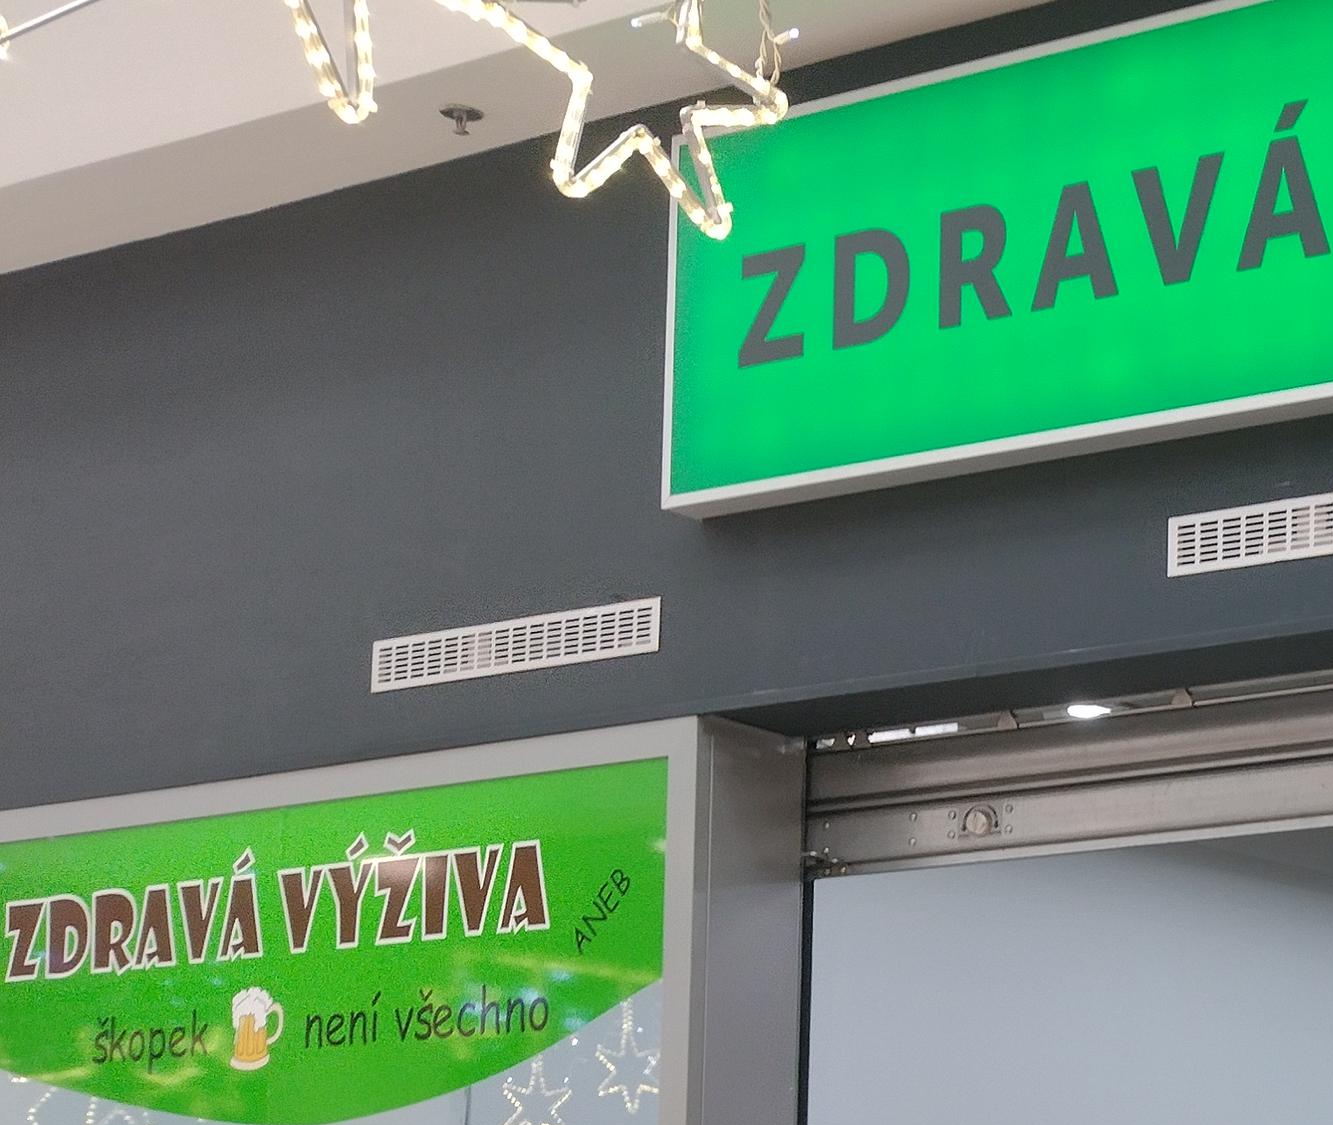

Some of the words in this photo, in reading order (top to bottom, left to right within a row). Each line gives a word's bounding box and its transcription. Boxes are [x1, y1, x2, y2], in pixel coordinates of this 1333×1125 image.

[738, 98, 1331, 369] ZDRAVÁ
[3, 847, 262, 982] ZDRAVÁ
[277, 828, 549, 954] VÝŽIVA
[572, 867, 632, 956] ANEB
[92, 1011, 210, 1073] škopek
[304, 990, 380, 1048] není
[395, 984, 549, 1042] všechno
